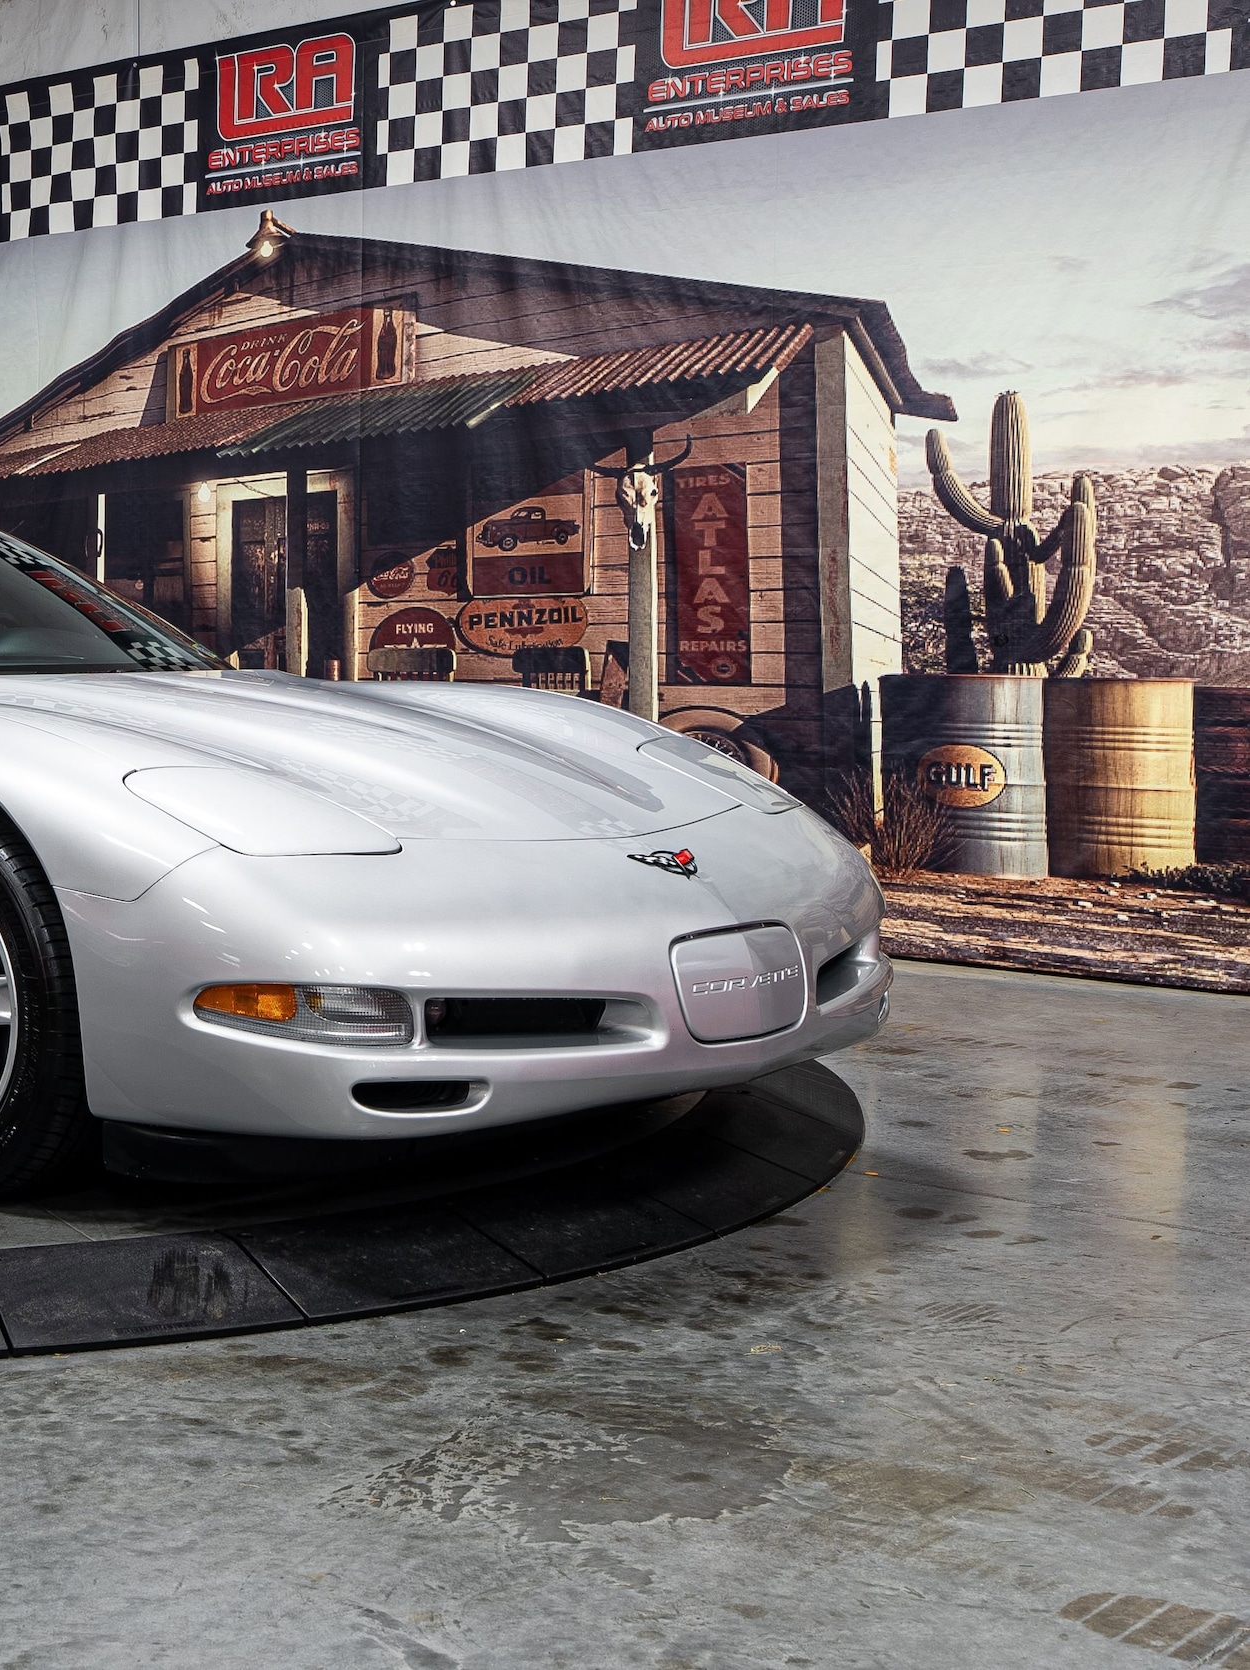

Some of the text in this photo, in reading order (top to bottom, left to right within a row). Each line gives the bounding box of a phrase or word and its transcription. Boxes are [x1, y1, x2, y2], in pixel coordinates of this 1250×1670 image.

[647, 50, 853, 102] ENTERPRISES
[645, 89, 850, 132] AUTO MUSEUM & SALES
[208, 127, 360, 169] ENTERPRISES
[206, 161, 359, 195] AUTO MUSEUM & SALES
[240, 332, 288, 351] DRINK
[201, 319, 366, 403] Coca-Cola
[677, 474, 731, 488] TIRES
[508, 566, 552, 586] OIL
[691, 492, 732, 634] ATLAS
[396, 623, 434, 634] FLYING
[469, 606, 583, 630] PENNZOIL
[486, 635, 506, 650] Safe
[679, 640, 747, 652] REPAIRS
[926, 761, 997, 792] GULF
[692, 965, 799, 996] CORVETTE
